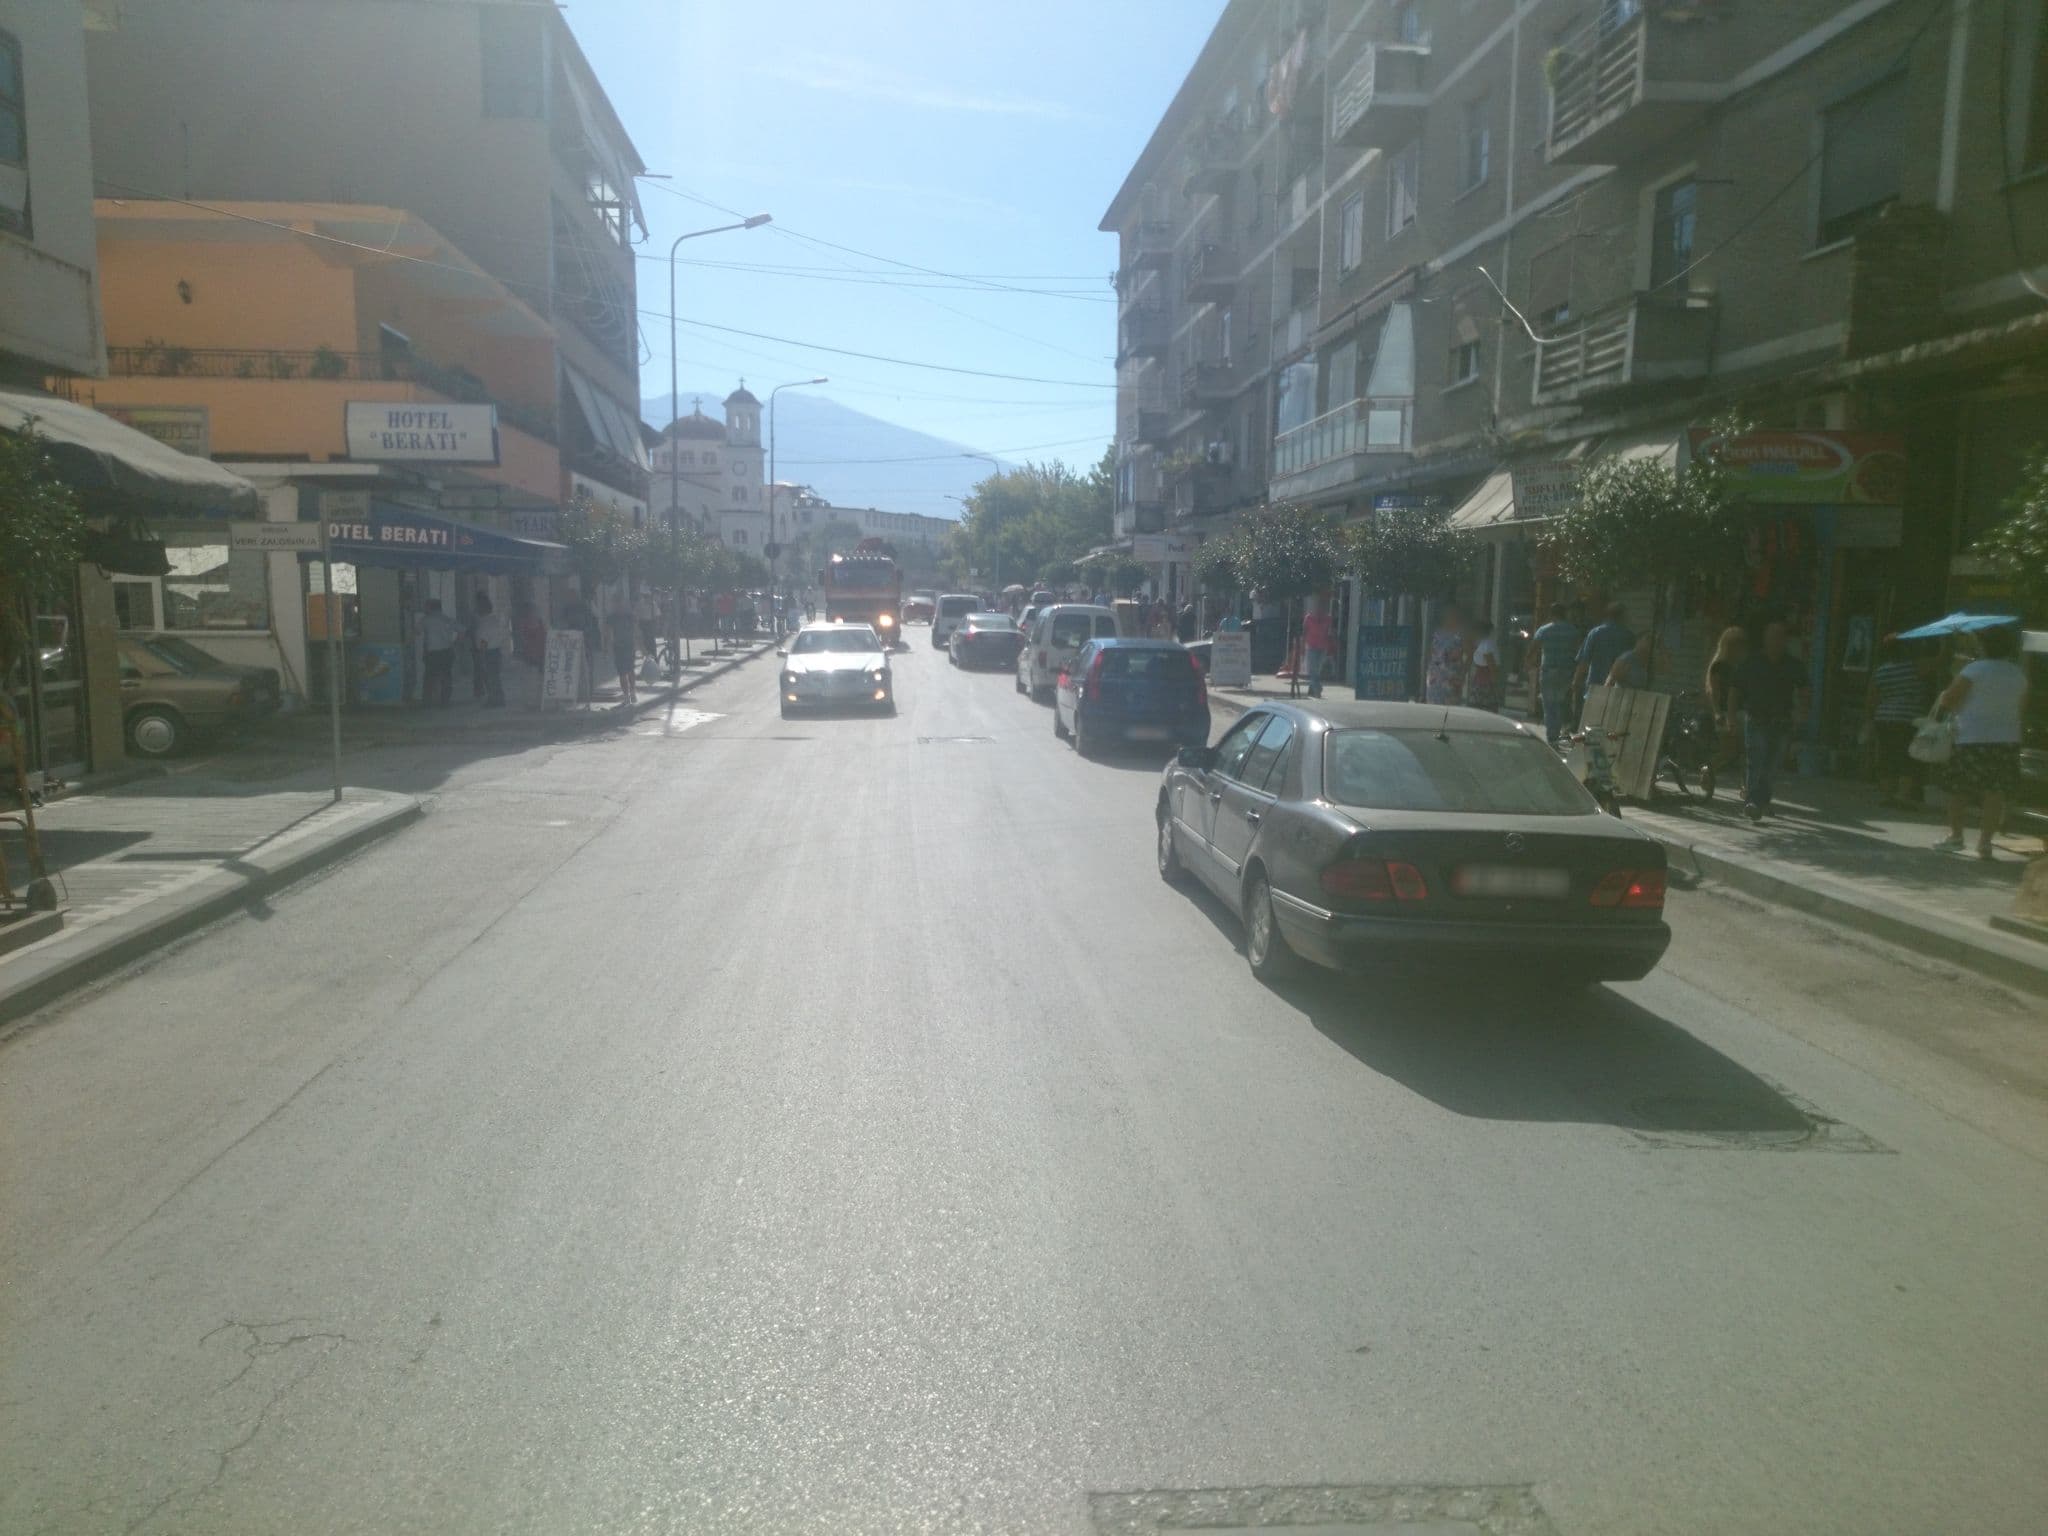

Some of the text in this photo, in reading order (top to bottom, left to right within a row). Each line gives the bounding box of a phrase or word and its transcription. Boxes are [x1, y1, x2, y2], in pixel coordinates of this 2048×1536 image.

[387, 410, 453, 430] HOTEL
[328, 523, 447, 545] OTEL BERATI
